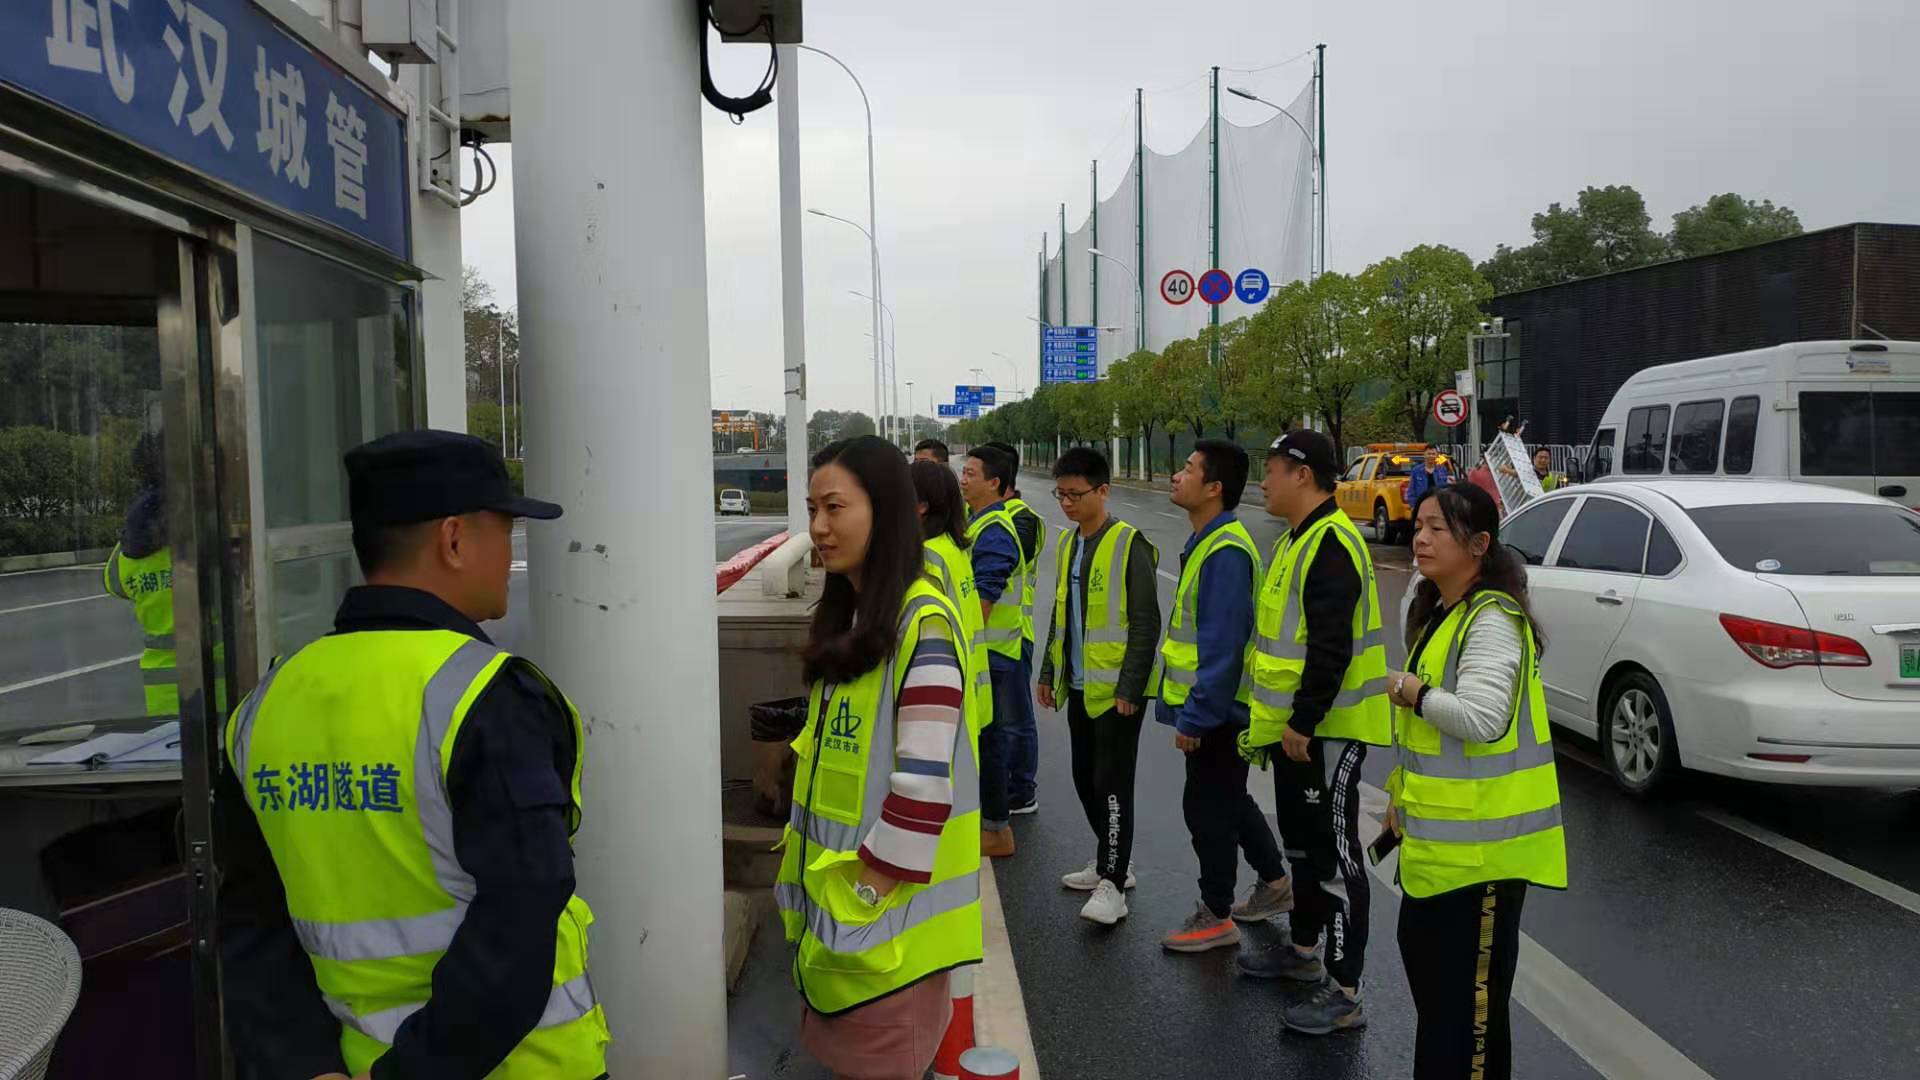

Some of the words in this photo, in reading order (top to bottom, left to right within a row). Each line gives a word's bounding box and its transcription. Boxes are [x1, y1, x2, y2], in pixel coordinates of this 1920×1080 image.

[45, 0, 368, 219] 武汉城管
[1167, 278, 1188, 296] 40
[1903, 648, 1920, 673] 鄂
[252, 761, 404, 813] 东湖隧道
[1108, 794, 1120, 846] athletics
